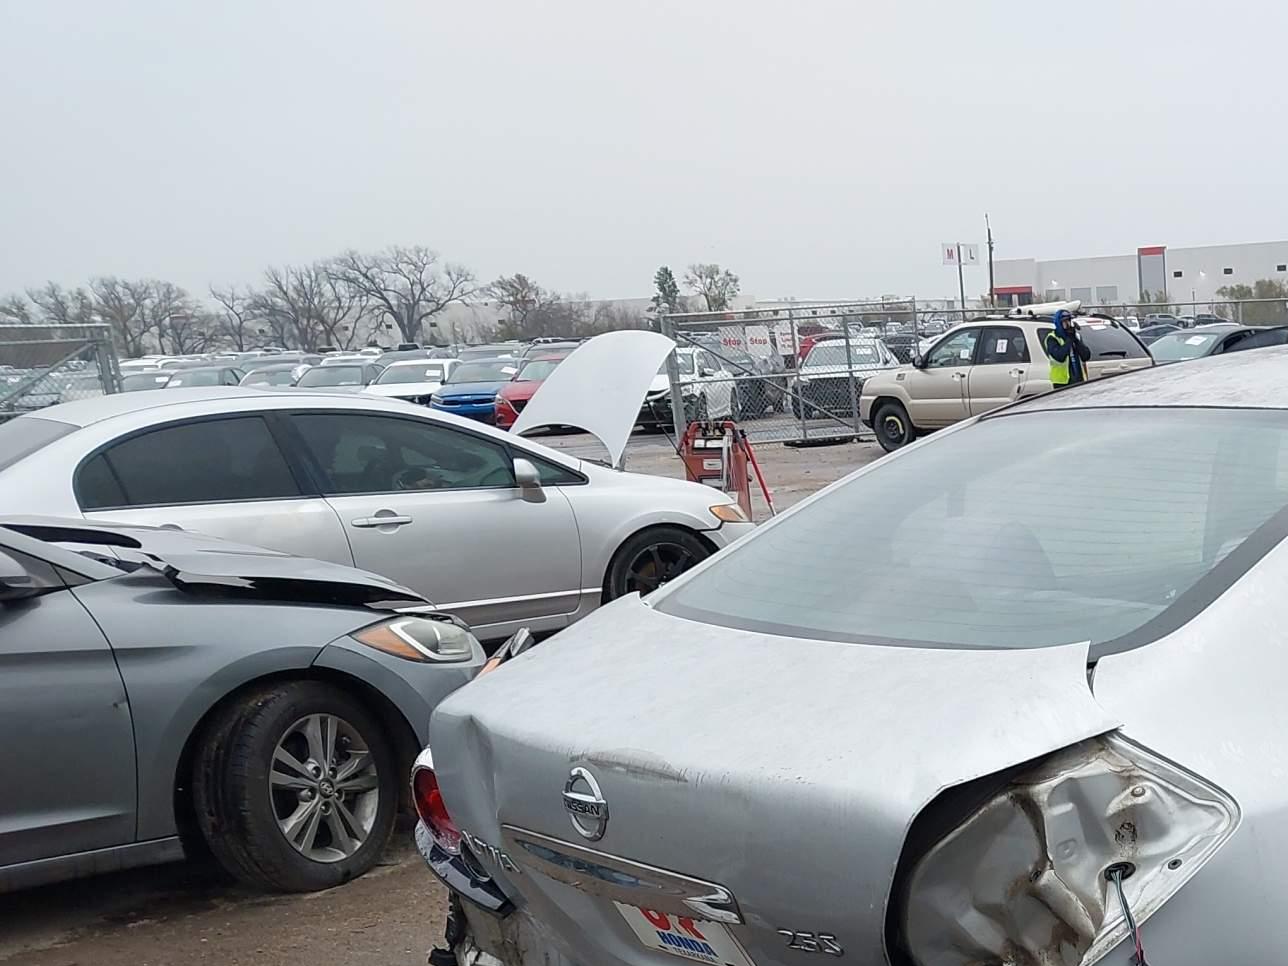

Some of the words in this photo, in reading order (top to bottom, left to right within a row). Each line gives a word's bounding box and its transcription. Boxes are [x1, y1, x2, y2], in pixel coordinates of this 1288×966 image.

[946, 248, 954, 260] M
[722, 337, 741, 346] Stop
[749, 336, 768, 345] Stop
[564, 799, 600, 817] NISSAN
[655, 930, 720, 958] HONDA
